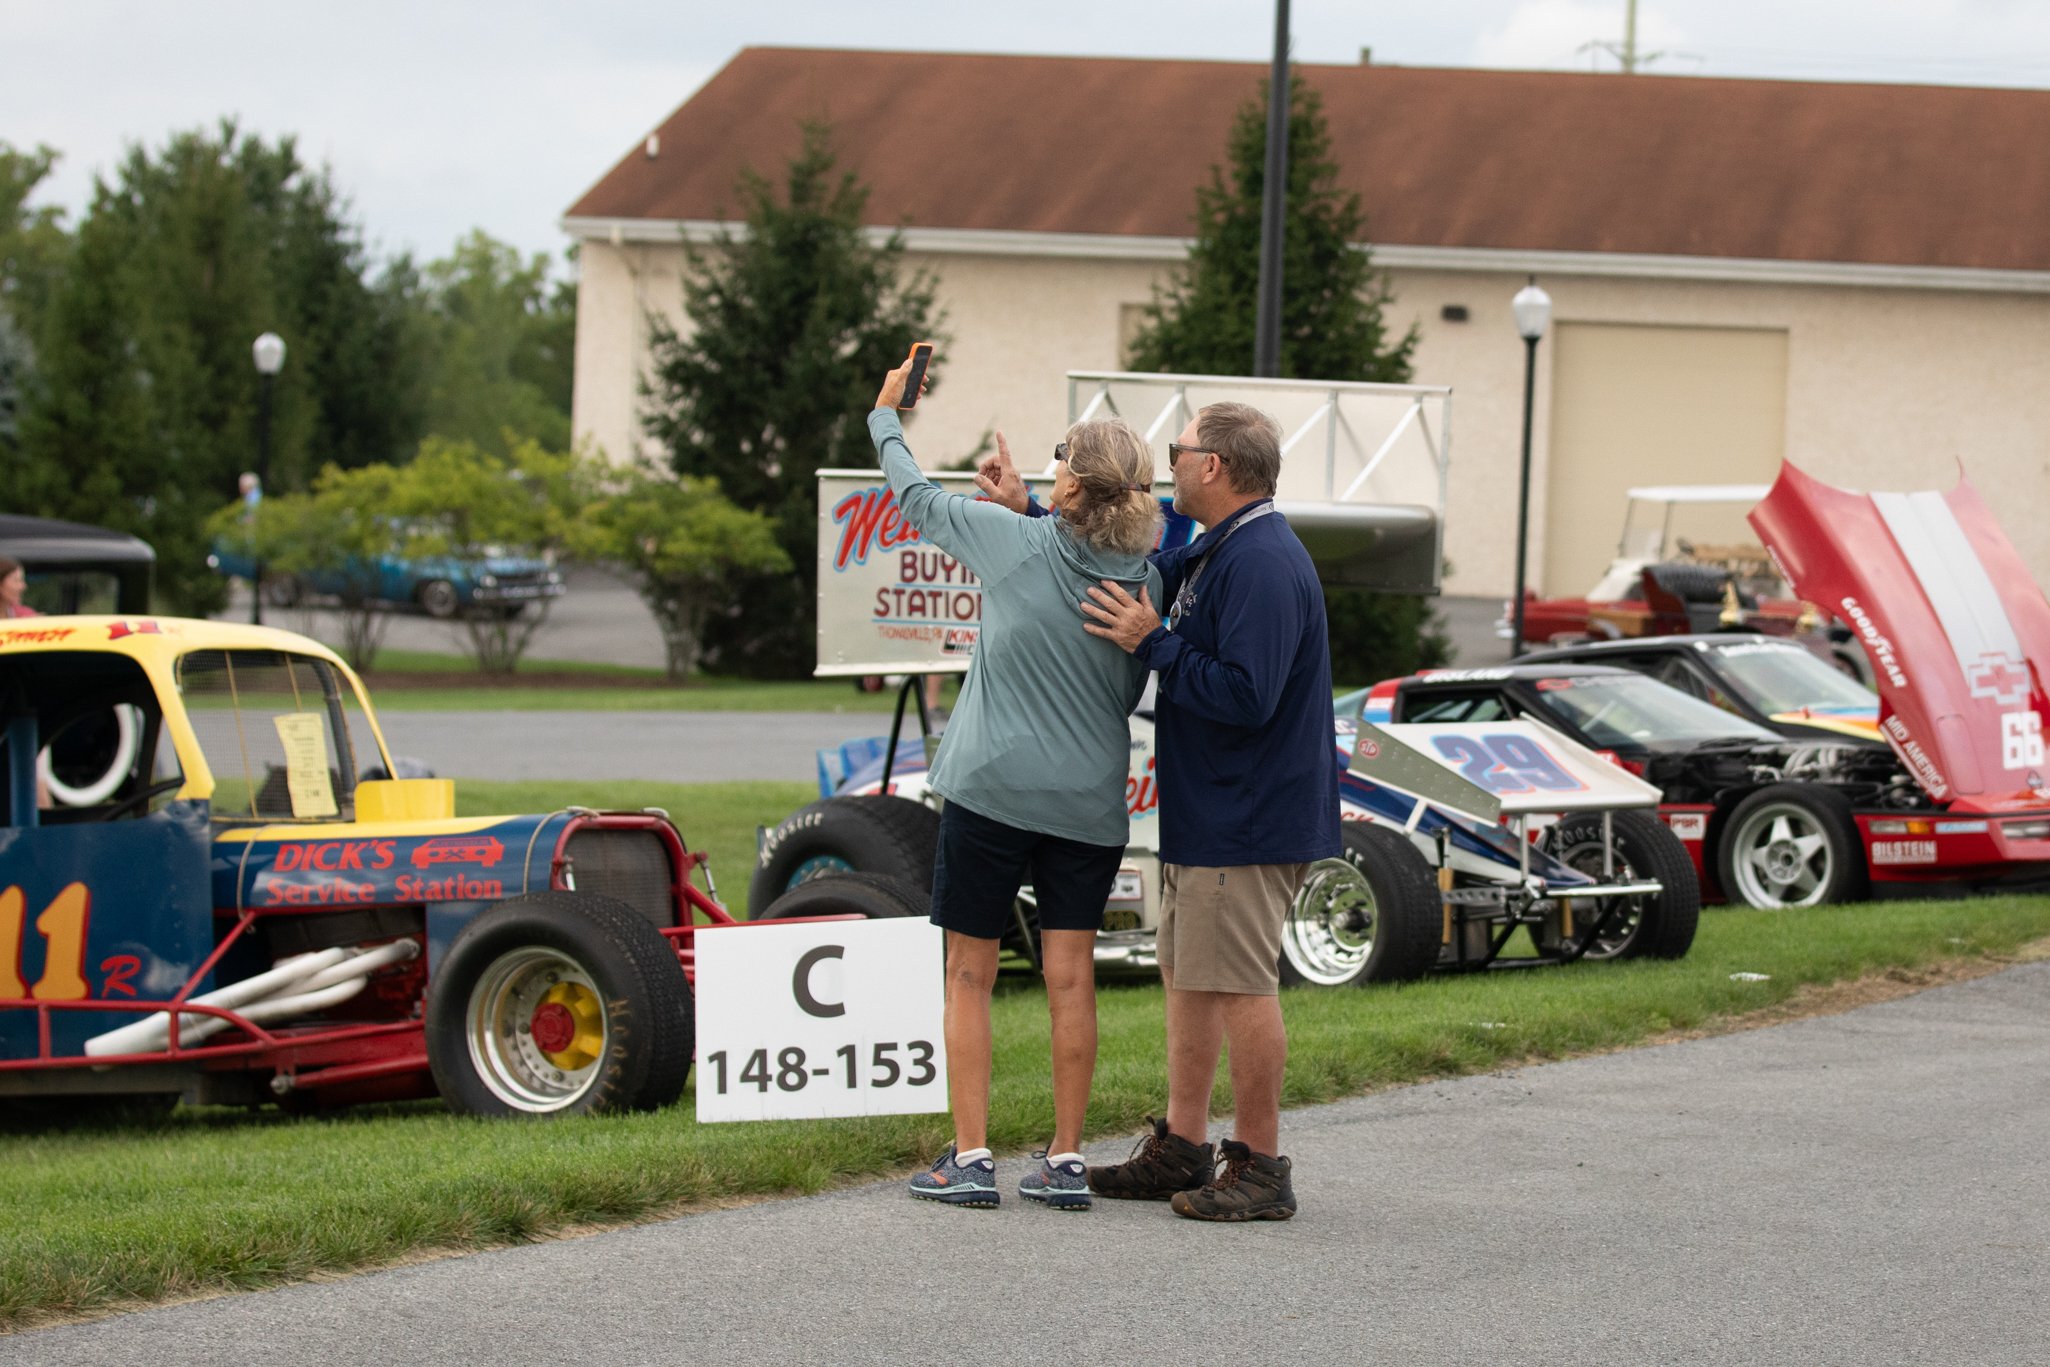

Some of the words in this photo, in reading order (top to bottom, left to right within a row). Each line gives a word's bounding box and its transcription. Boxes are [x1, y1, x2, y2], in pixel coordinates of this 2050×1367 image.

[1841, 596, 1908, 688] GOODYEAR
[1430, 732, 1590, 794] 29
[1885, 714, 1910, 742] MID
[1903, 740, 1948, 799] AMERICA
[2001, 710, 2045, 770] 66
[273, 840, 397, 872] DICK'S
[1872, 841, 1937, 858] BILSTEIN
[266, 876, 376, 905] Service
[394, 872, 503, 901] Station
[100, 954, 142, 999] R
[792, 944, 846, 1018] C
[707, 1039, 937, 1095] 148-153
